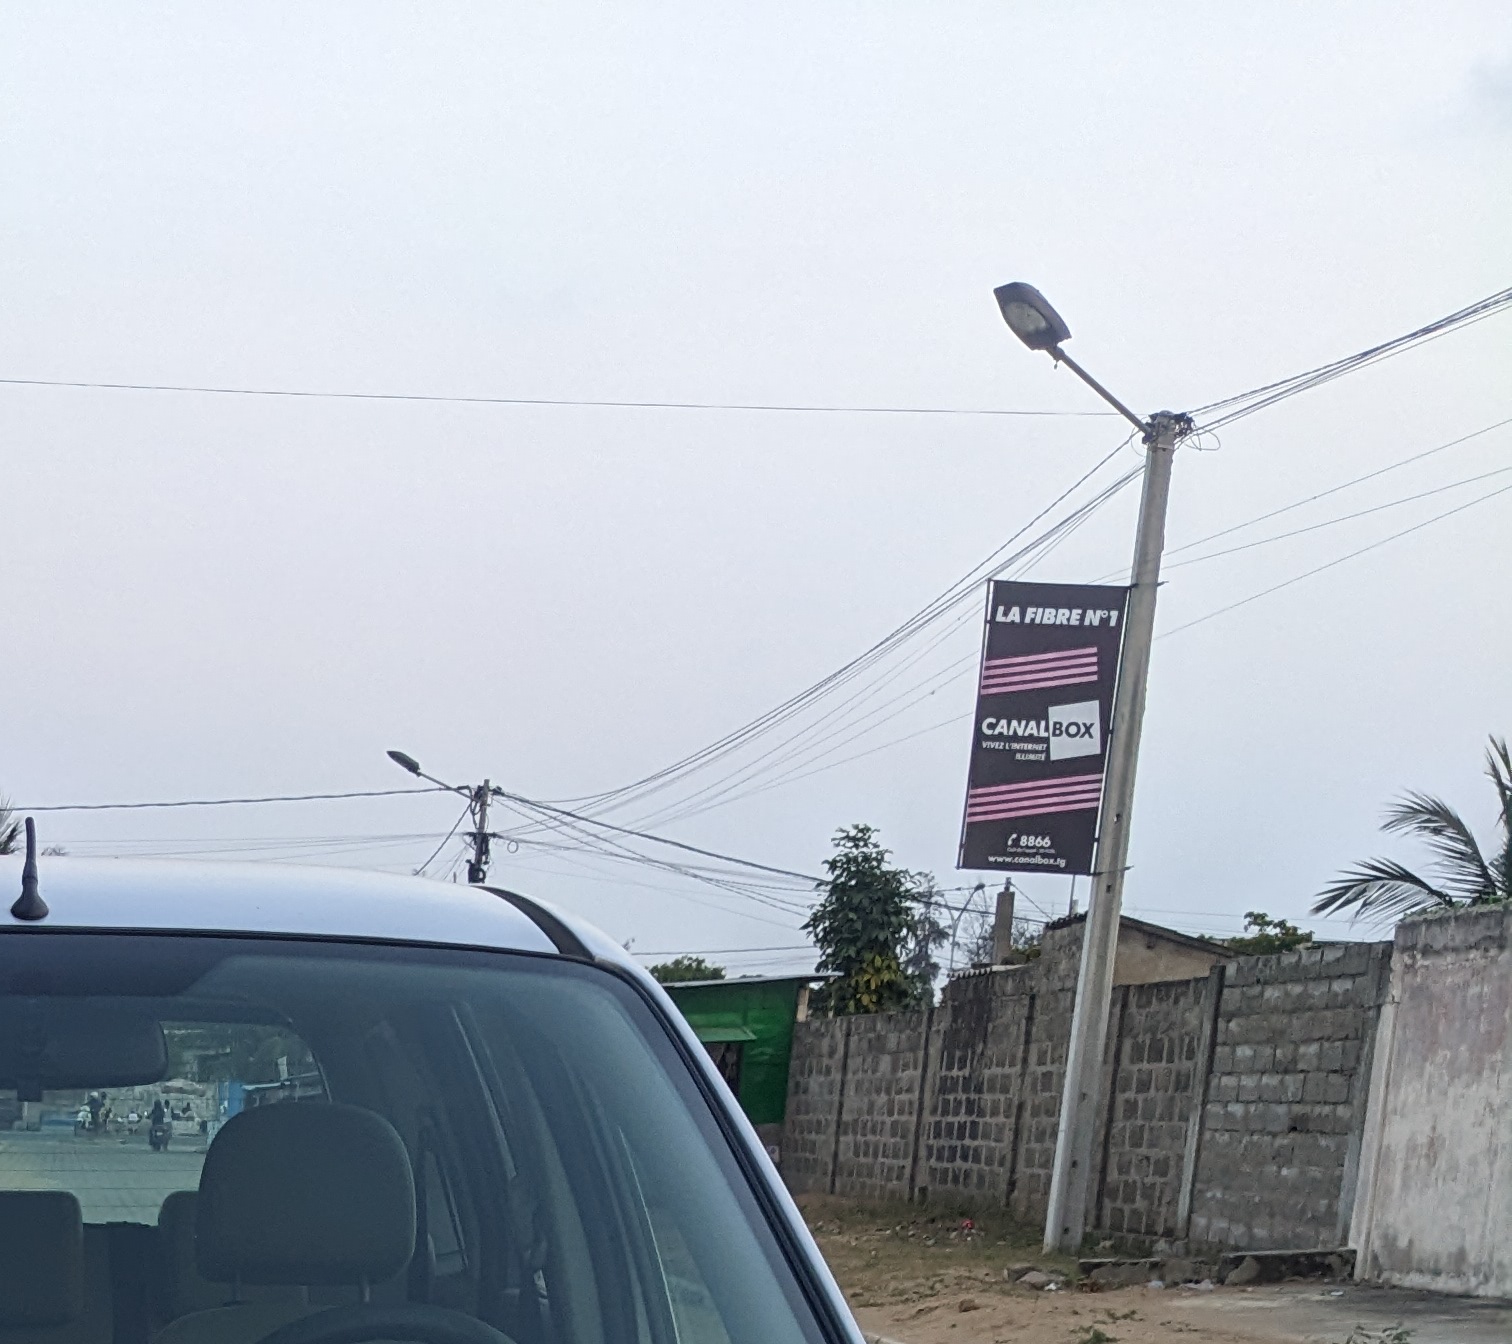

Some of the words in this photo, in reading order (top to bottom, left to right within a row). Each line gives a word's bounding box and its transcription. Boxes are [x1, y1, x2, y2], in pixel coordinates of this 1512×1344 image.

[995, 605, 1021, 623] LA
[1024, 607, 1083, 626] FIBRE
[1084, 609, 1119, 627] N°1
[1019, 835, 1052, 848] 8866
[988, 855, 1066, 868] www.canalbox.tg
